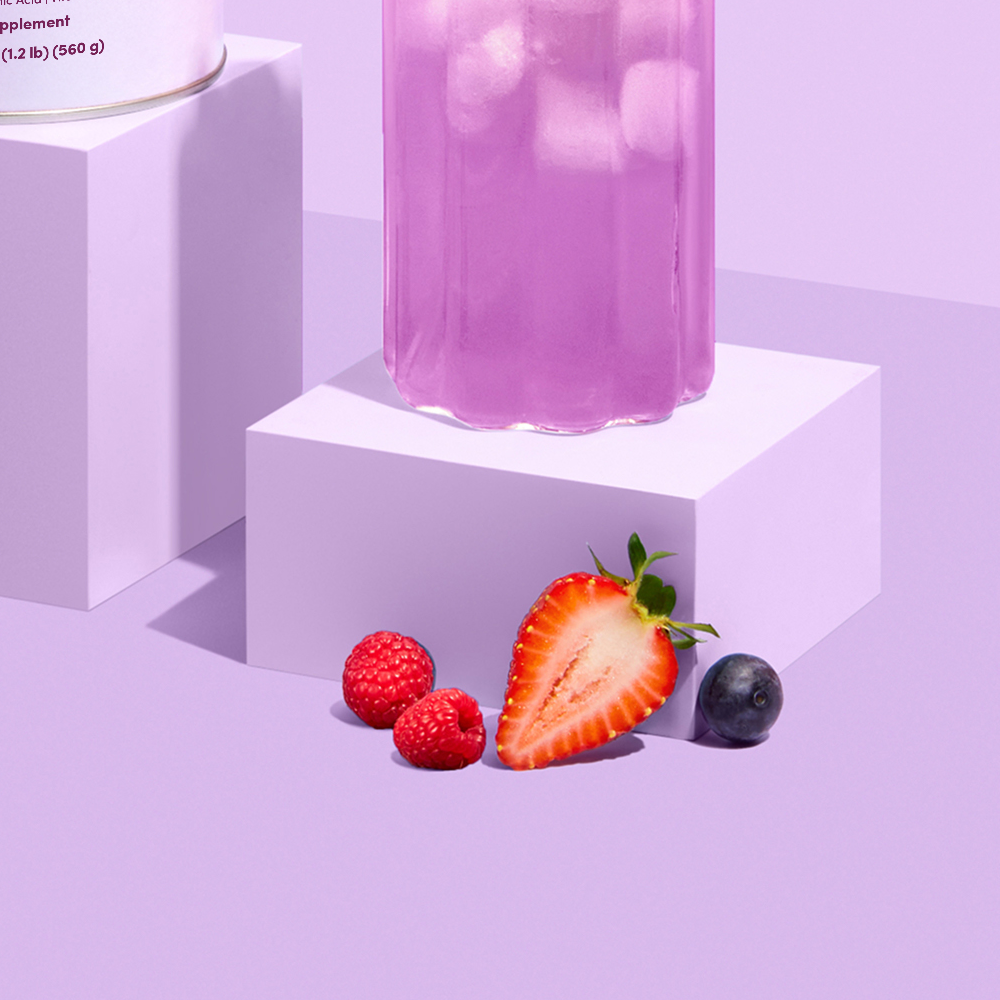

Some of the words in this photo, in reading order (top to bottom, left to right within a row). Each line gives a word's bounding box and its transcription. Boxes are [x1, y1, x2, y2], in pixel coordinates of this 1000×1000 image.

[1, 47, 26, 64] (1.2
[29, 45, 50, 62] lb)
[52, 41, 86, 61] (560
[89, 38, 105, 56] g)
